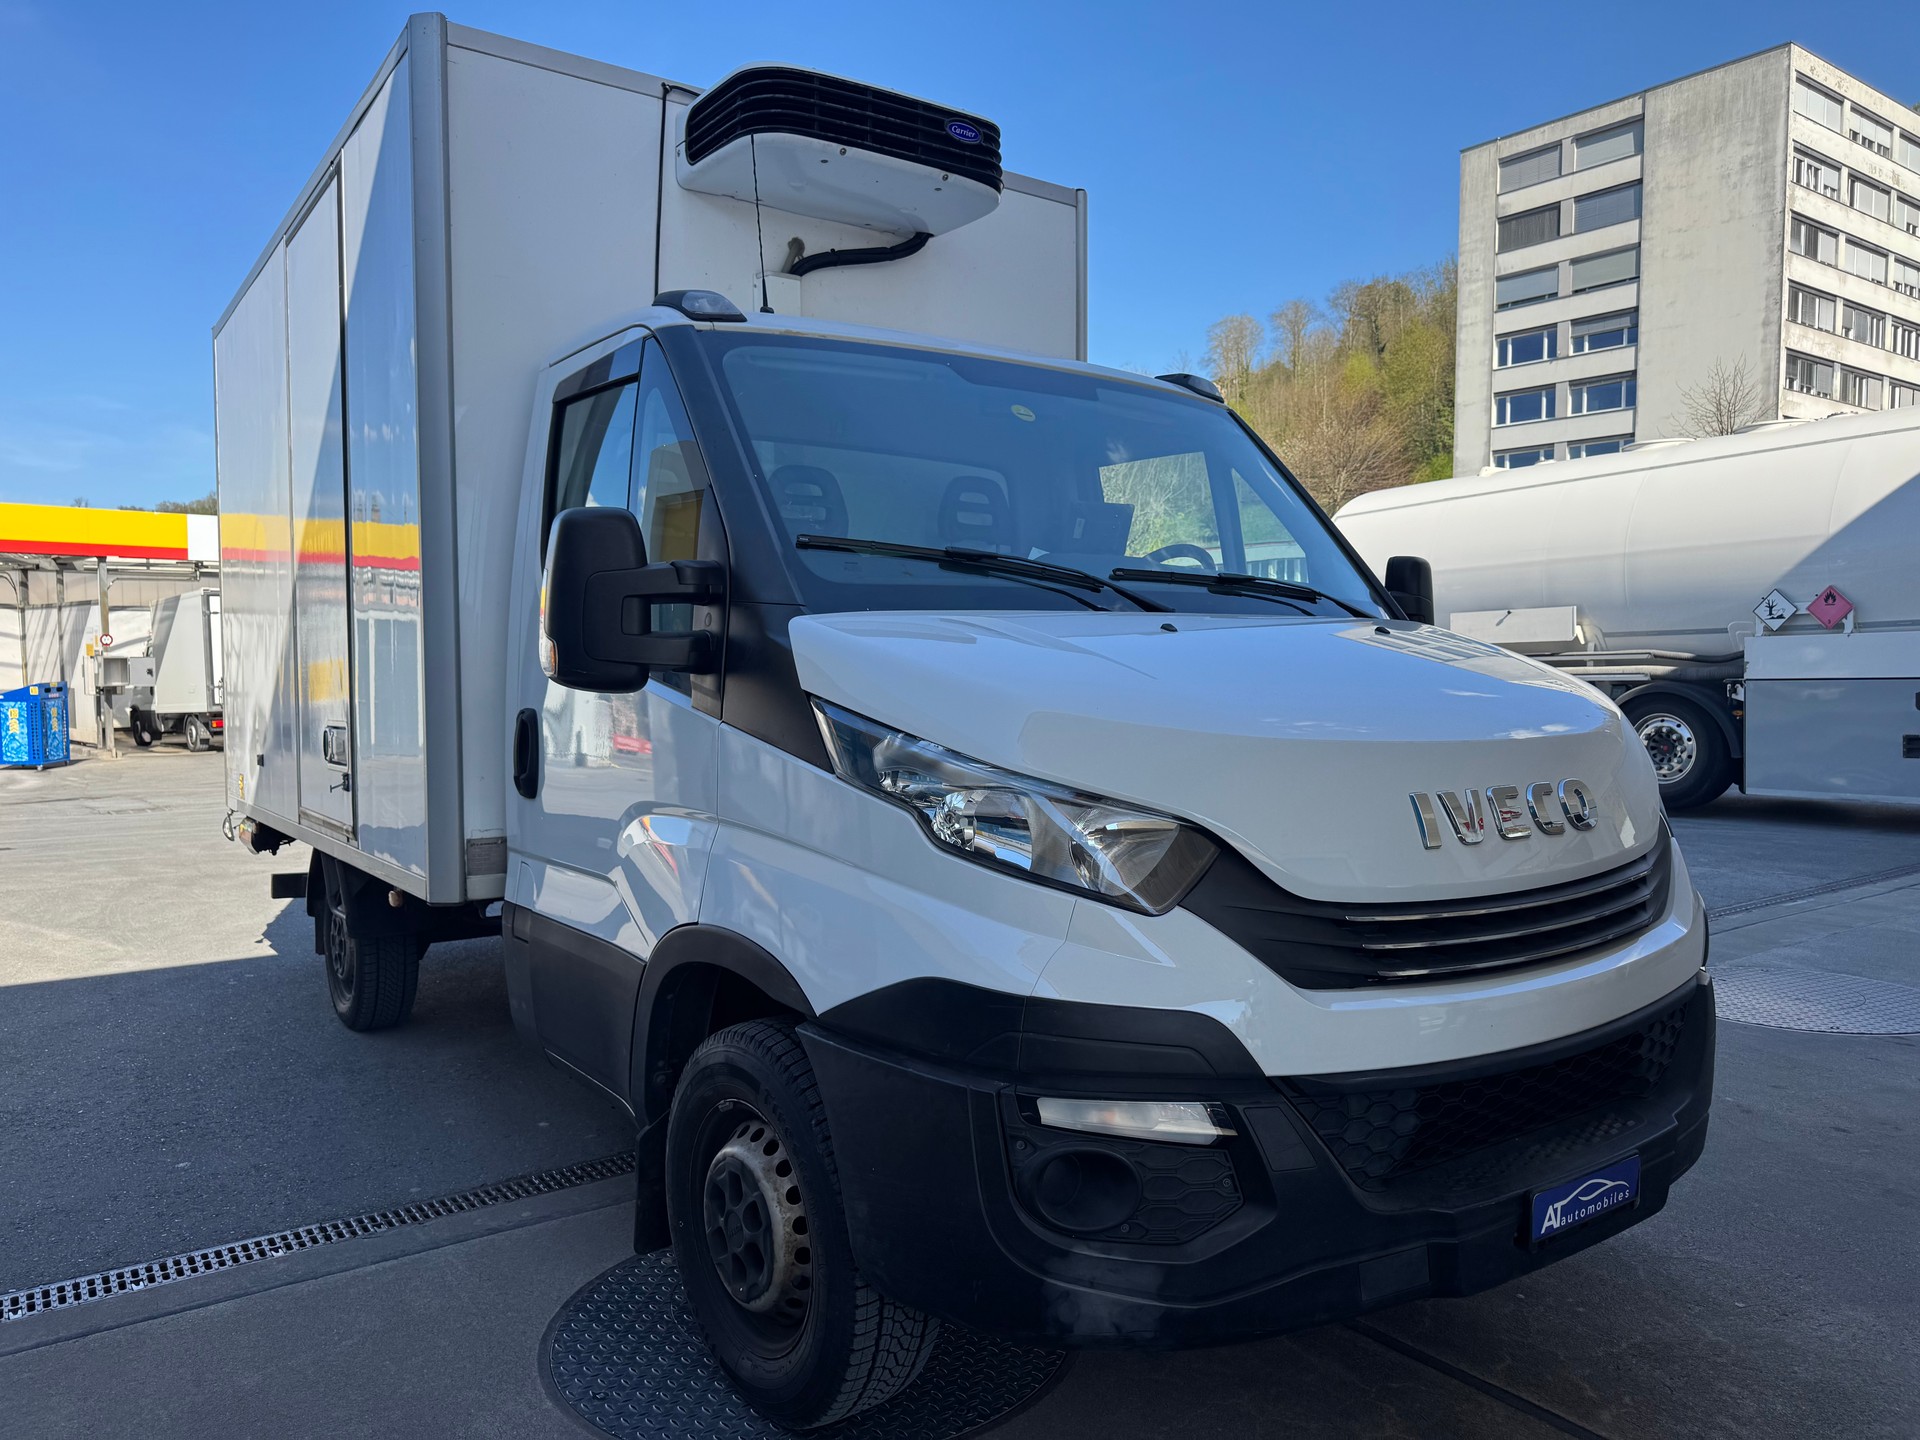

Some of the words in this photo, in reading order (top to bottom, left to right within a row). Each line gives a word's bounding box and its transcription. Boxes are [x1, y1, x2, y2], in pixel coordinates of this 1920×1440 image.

[951, 125, 976, 138] Carrier
[1409, 778, 1599, 850] IVECO
[1561, 1189, 1630, 1226] automobiles
